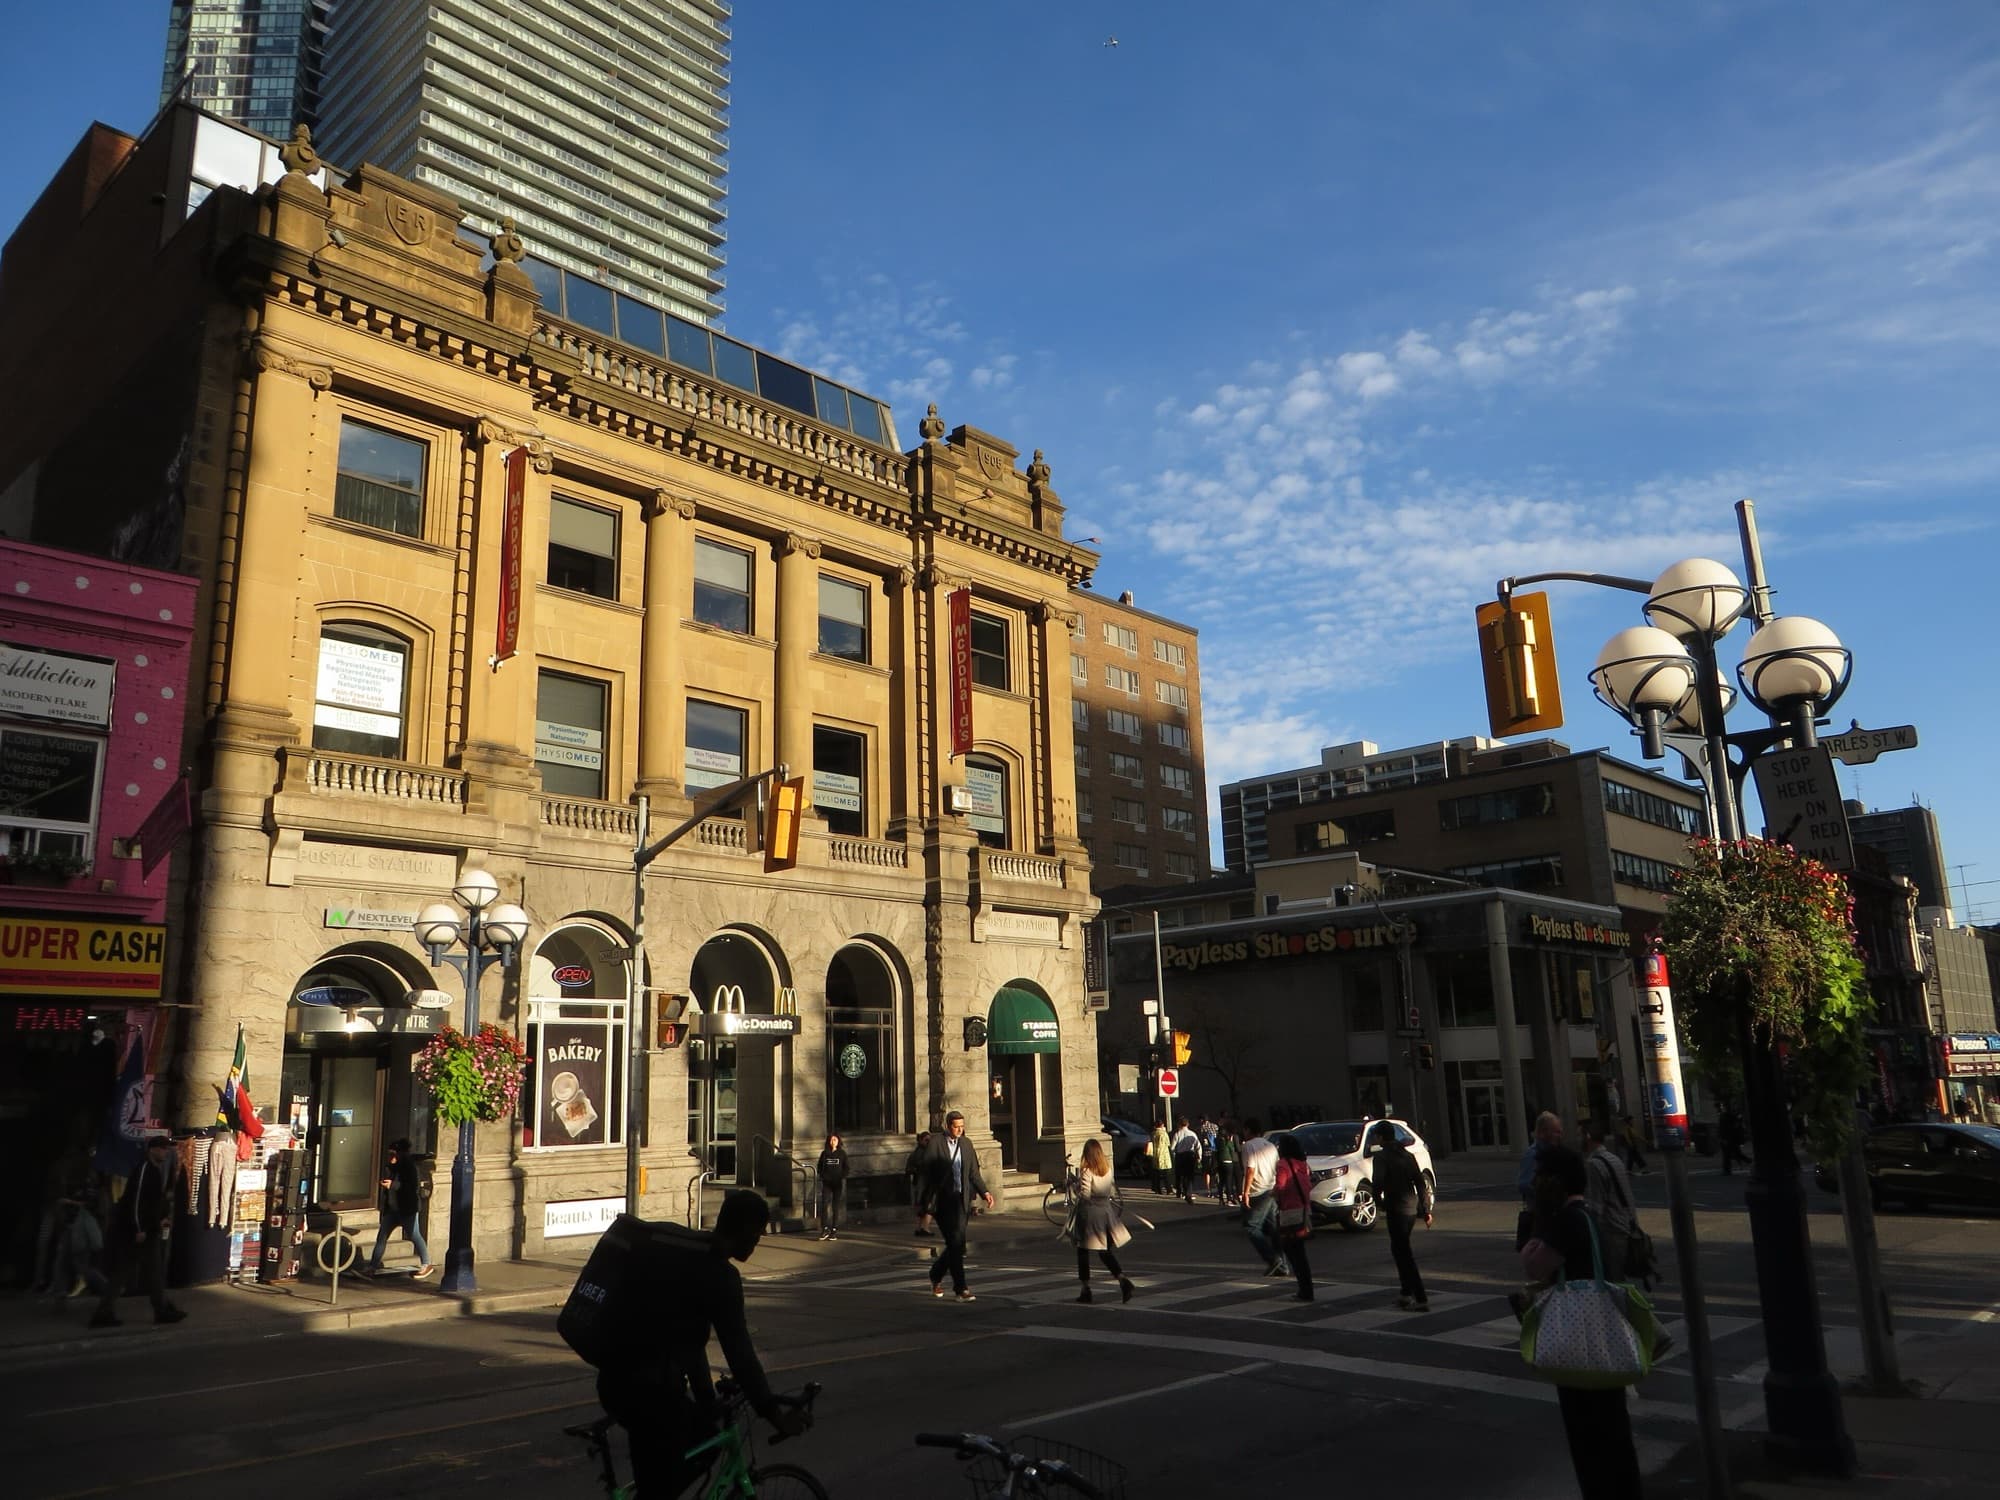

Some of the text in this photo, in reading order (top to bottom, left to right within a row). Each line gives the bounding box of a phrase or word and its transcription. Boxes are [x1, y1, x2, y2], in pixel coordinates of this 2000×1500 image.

[322, 641, 400, 663] PHYSIOMED
[0, 655, 97, 689] Addiction
[1, 689, 88, 709] MODERN FLARE
[536, 747, 598, 764] PHYSIOMED
[1771, 756, 1810, 777] STOP
[1776, 778, 1818, 800] HERE
[1806, 800, 1827, 817] ON
[1810, 822, 1841, 841] RED
[297, 848, 361, 869] POSTAL
[368, 854, 434, 874] STATION
[358, 913, 414, 924] NEXTLEVEL
[1530, 914, 1631, 947] Payless ShoeSource
[89, 929, 163, 964] CASH
[1162, 940, 1248, 971] Payless
[556, 969, 591, 981] OPEN
[734, 1018, 794, 1031] McDonald's
[1951, 1036, 1988, 1051] Panasonic
[548, 1044, 602, 1064] BAKERY
[578, 1279, 607, 1304] UBER
